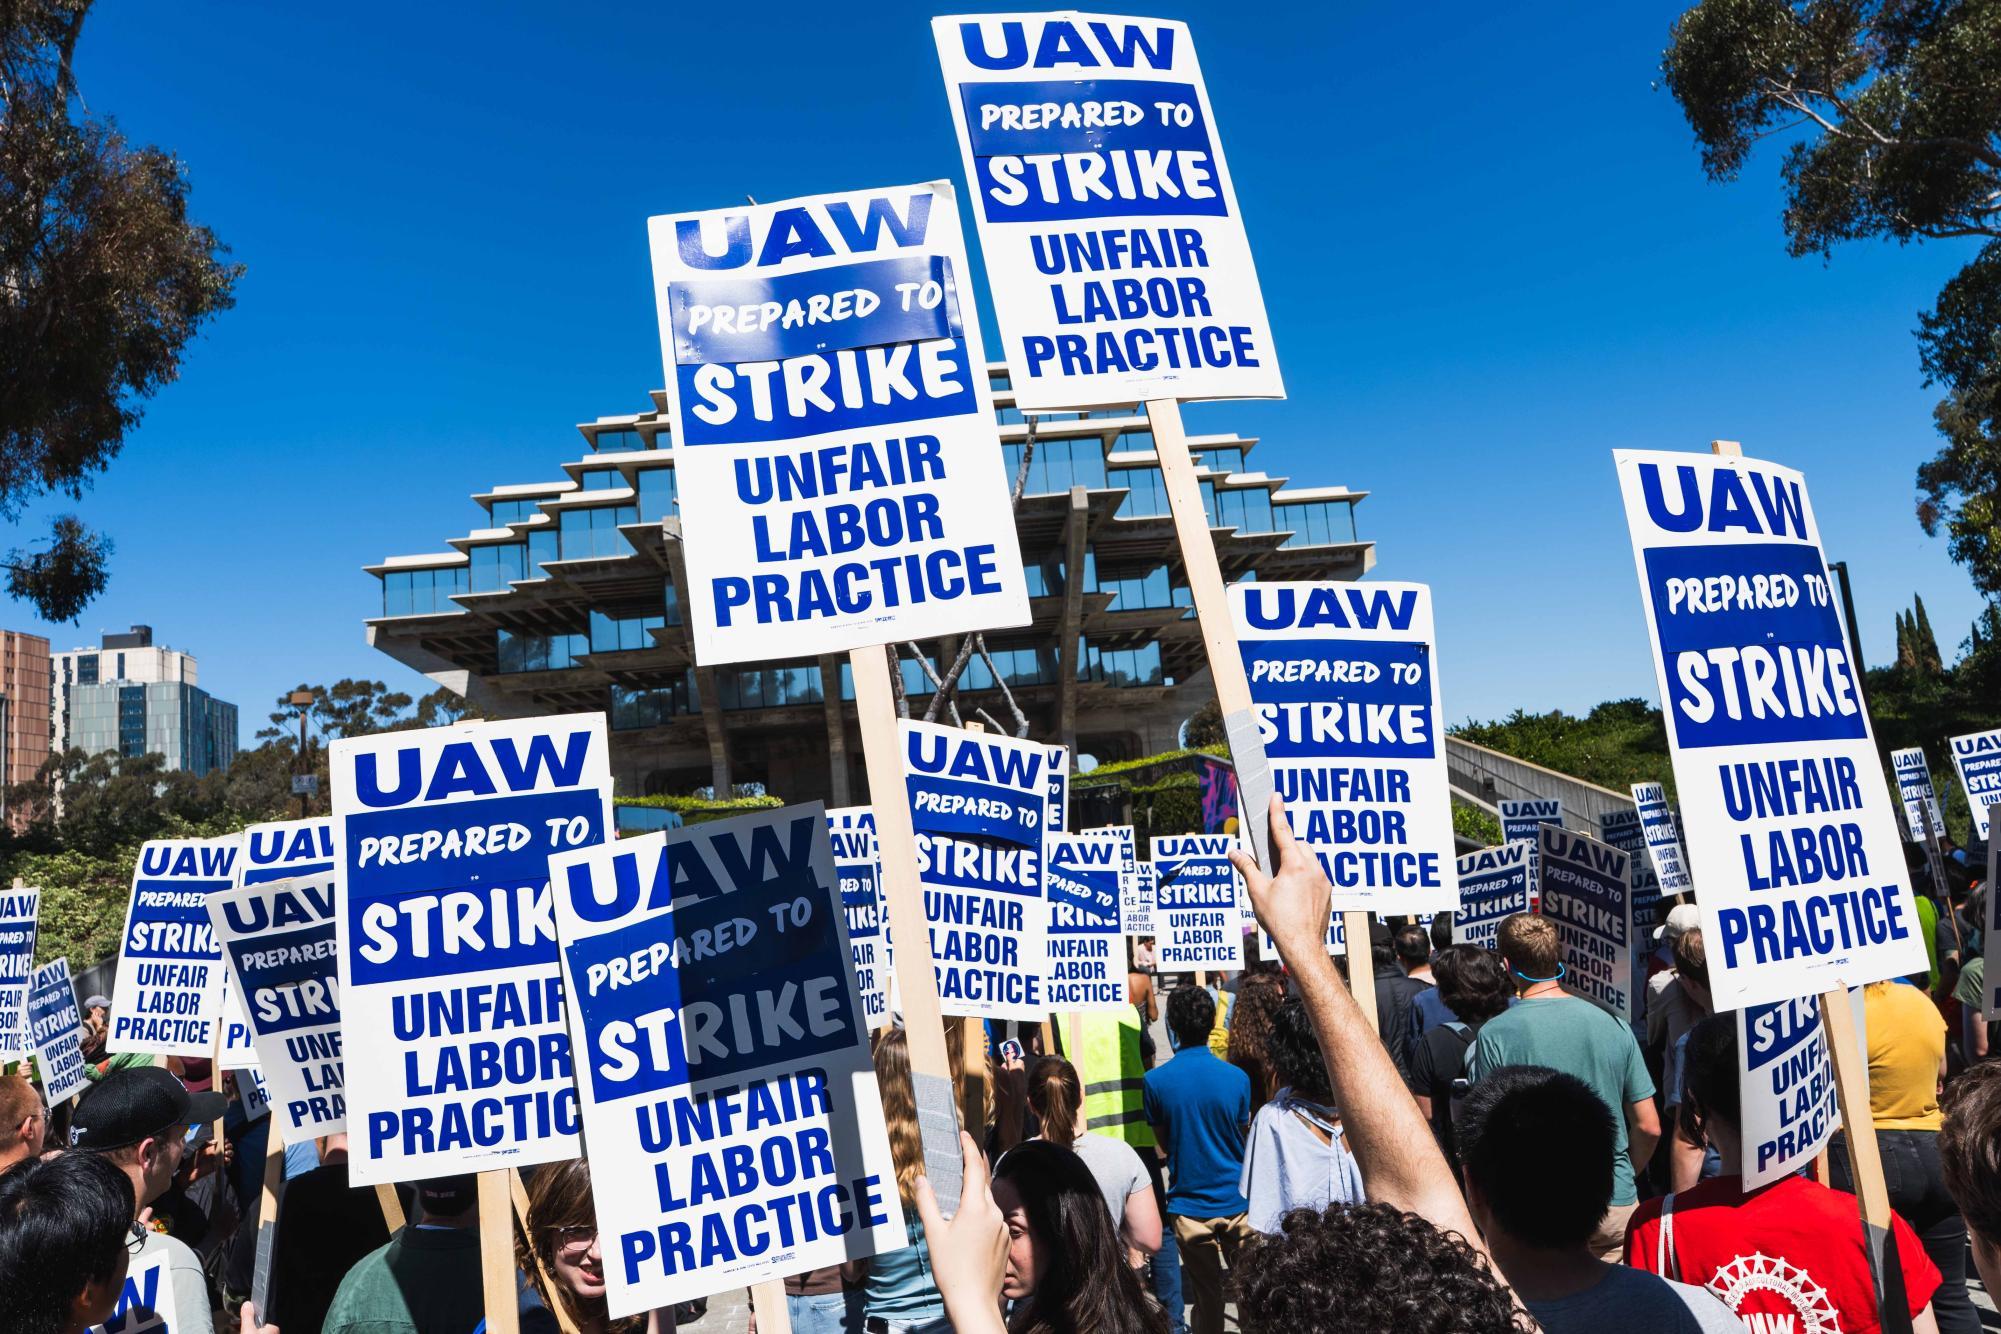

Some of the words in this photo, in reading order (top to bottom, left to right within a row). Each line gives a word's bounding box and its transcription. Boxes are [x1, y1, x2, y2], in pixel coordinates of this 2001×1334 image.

[959, 21, 1175, 70] UAW
[980, 101, 1145, 130] PREPARED
[1154, 102, 1194, 128] TO
[989, 149, 1216, 207] STRIKE
[675, 193, 933, 271] UAW
[1030, 228, 1209, 275] UNFAIR
[688, 289, 880, 336] PREPARED
[895, 281, 942, 312] TO
[1051, 277, 1212, 324] LABOR
[1022, 326, 1260, 378] PRACTICE
[692, 337, 964, 425] STRIKE
[734, 434, 946, 505] UNFAIR
[1638, 463, 1807, 541] UAW
[752, 493, 945, 563] LABOR
[711, 544, 1002, 627] PRACTICE
[1666, 573, 1800, 616] PREPARED
[1803, 574, 1828, 607] TO
[1244, 588, 1418, 631] UAW
[1251, 659, 1381, 684] PREPARED
[1389, 663, 1421, 685] TO
[1677, 644, 1858, 725] STRIKE
[1256, 702, 1427, 744] STRIKE
[354, 731, 592, 808] UAW
[908, 730, 1042, 789] UAW
[1894, 752, 1923, 768] UAW
[1274, 768, 1411, 803] UNFAIR
[1635, 786, 1664, 802] UAW
[1718, 756, 1863, 823] UNFAIR
[1903, 784, 1932, 800] STRIKE
[914, 791, 1012, 820] PREPARED
[1018, 807, 1038, 828] TO
[1502, 801, 1559, 817] UAW
[1641, 810, 1661, 820] PREPARED
[358, 823, 532, 868] PREPARED
[546, 815, 590, 848] TO
[1285, 809, 1406, 845] LABOR
[1645, 823, 1675, 843] STRIKE
[142, 846, 239, 877] UAW
[831, 833, 868, 859] AW
[914, 833, 1038, 887] STRIKE
[1050, 842, 1114, 865] AW
[1157, 838, 1229, 857] UAW
[1457, 845, 1524, 875] UAW
[1543, 829, 1626, 878] UAW
[1656, 848, 1678, 861] UNFAIR
[1741, 822, 1870, 892] LABOR
[567, 815, 816, 923] UAW
[861, 878, 872, 893] TO
[1215, 865, 1230, 876] TO
[1458, 879, 1508, 896] PREPARED
[1511, 874, 1523, 885] TO
[1546, 865, 1604, 895] PREPARED
[1607, 887, 1622, 903] TO
[1661, 874, 1691, 890] PRACTICE
[1662, 862, 1681, 875] LABOR
[138, 891, 206, 908] PREPARED
[1047, 873, 1092, 899] EPARED
[1095, 890, 1114, 907] TO
[1159, 883, 1232, 905] STRIKE
[1455, 891, 1524, 920] STRIKE
[360, 880, 557, 964] STRIK
[845, 905, 878, 930] IKE
[924, 890, 1023, 932] UNFAIR
[1170, 913, 1225, 928] UNFAIR
[1545, 890, 1623, 940] STRIKE
[1718, 884, 1909, 969] PRACTICE
[0, 932, 24, 944] PARED
[26, 931, 33, 943] TO
[129, 921, 220, 953] STRIKE
[587, 916, 758, 997] PREPARED
[769, 896, 812, 934] TO
[853, 943, 875, 966] AIR
[929, 928, 1018, 967] LABOR
[1047, 939, 1108, 959] NFAIR
[1163, 946, 1237, 963] PRACTICE
[1173, 929, 1223, 945] LABOR
[1557, 923, 1616, 964] UNFAIR
[0, 954, 30, 978] RIKE
[137, 964, 208, 988] UNFAIR
[1048, 961, 1106, 981] ABOR
[1562, 949, 1612, 983] ABOR
[0, 990, 22, 1008] FAIR
[29, 990, 61, 1012] PREPARED
[61, 986, 70, 998] TO
[137, 991, 200, 1016] LABOR
[254, 976, 340, 1023] STRI
[34, 1005, 78, 1041] STRIKE
[115, 1017, 210, 1044] PRACTICE
[598, 975, 846, 1083] STRIKE
[45, 1033, 80, 1061] UNFAIR
[51, 1051, 81, 1077] LABOR
[286, 1031, 342, 1063] UNF
[1772, 1030, 1828, 1095] UNFA
[48, 1065, 85, 1097] PRACTIC
[405, 1032, 573, 1098] LABOR
[368, 1087, 583, 1160] PRACTIC
[636, 1066, 833, 1154] UNFAIR
[655, 1127, 836, 1214] LABOR
[620, 1175, 889, 1285] PRACTICE
